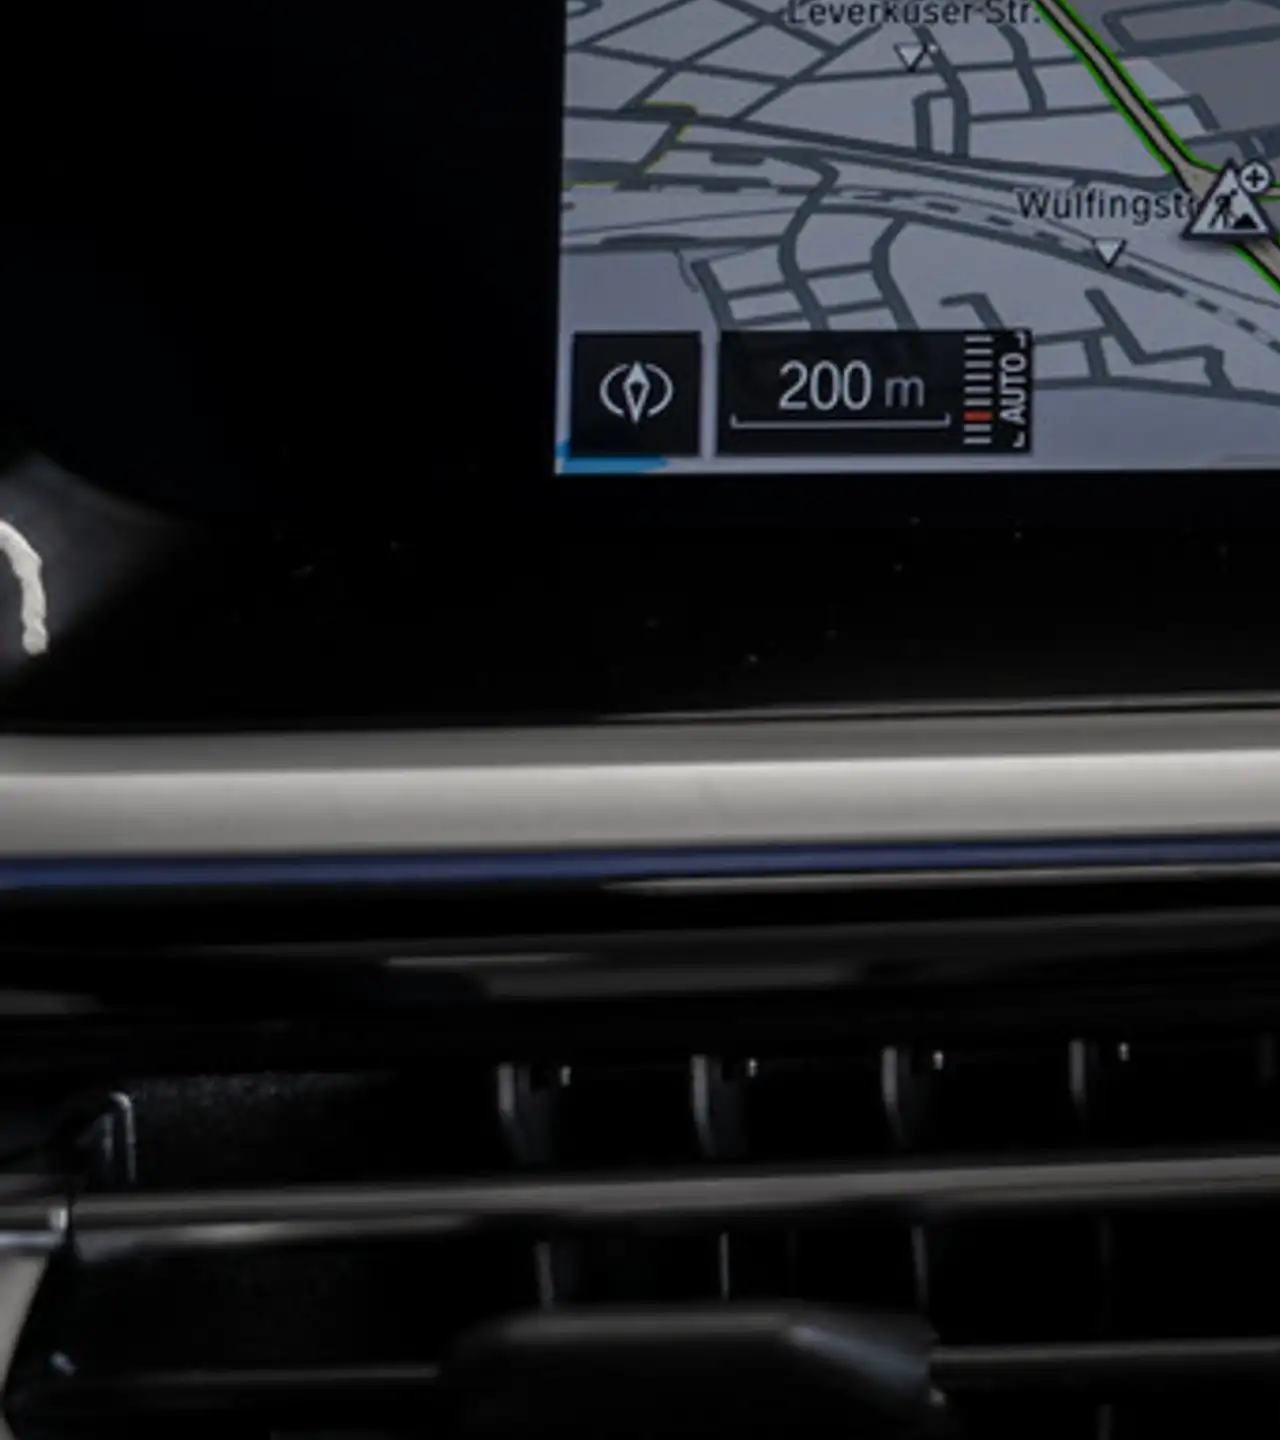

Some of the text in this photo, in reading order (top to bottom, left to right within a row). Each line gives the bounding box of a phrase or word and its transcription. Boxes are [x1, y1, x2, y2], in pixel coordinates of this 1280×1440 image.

[778, 360, 926, 410] 200 m
[1000, 353, 1027, 424] AUTO
